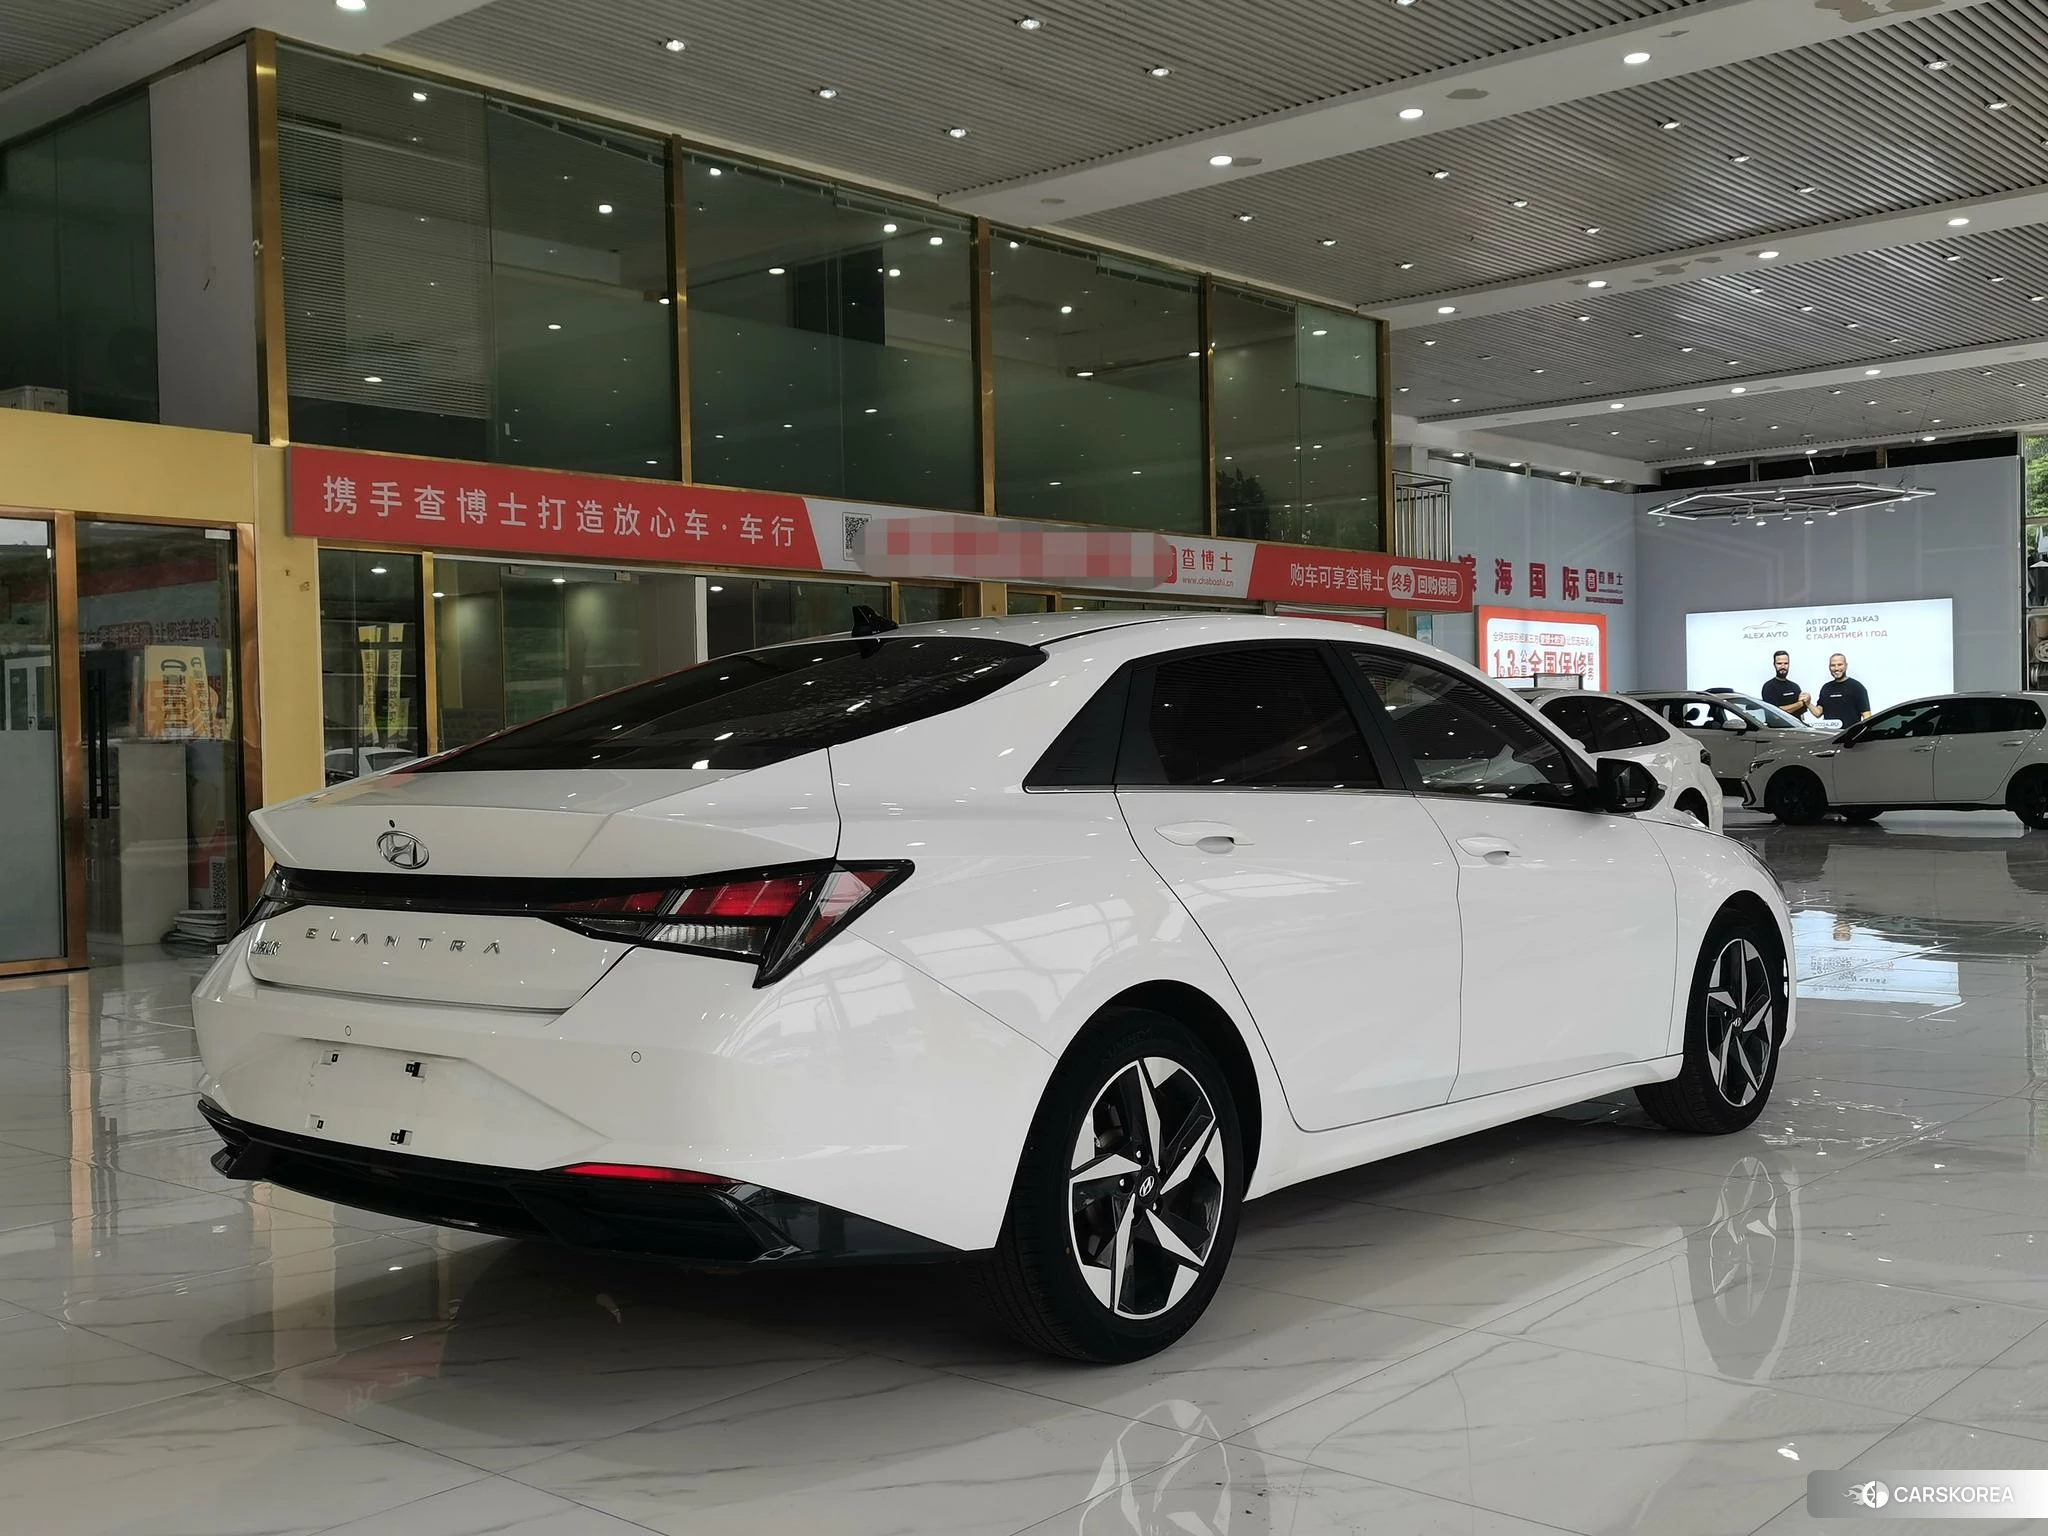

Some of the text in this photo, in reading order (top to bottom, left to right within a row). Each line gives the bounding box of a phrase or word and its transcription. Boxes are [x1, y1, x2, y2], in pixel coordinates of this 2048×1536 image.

[1182, 548, 1233, 573] 查博士
[1290, 562, 1458, 598] 购车可享查博士 终身 回购保障
[1806, 615, 1879, 626] АВТО ПОД ЗАКАЗ
[1743, 632, 1765, 640] ALEX
[1813, 630, 1863, 640] ГАРАНТИЕЙ
[1870, 630, 1888, 638] ГОД
[305, 928, 501, 954] ELANTRA
